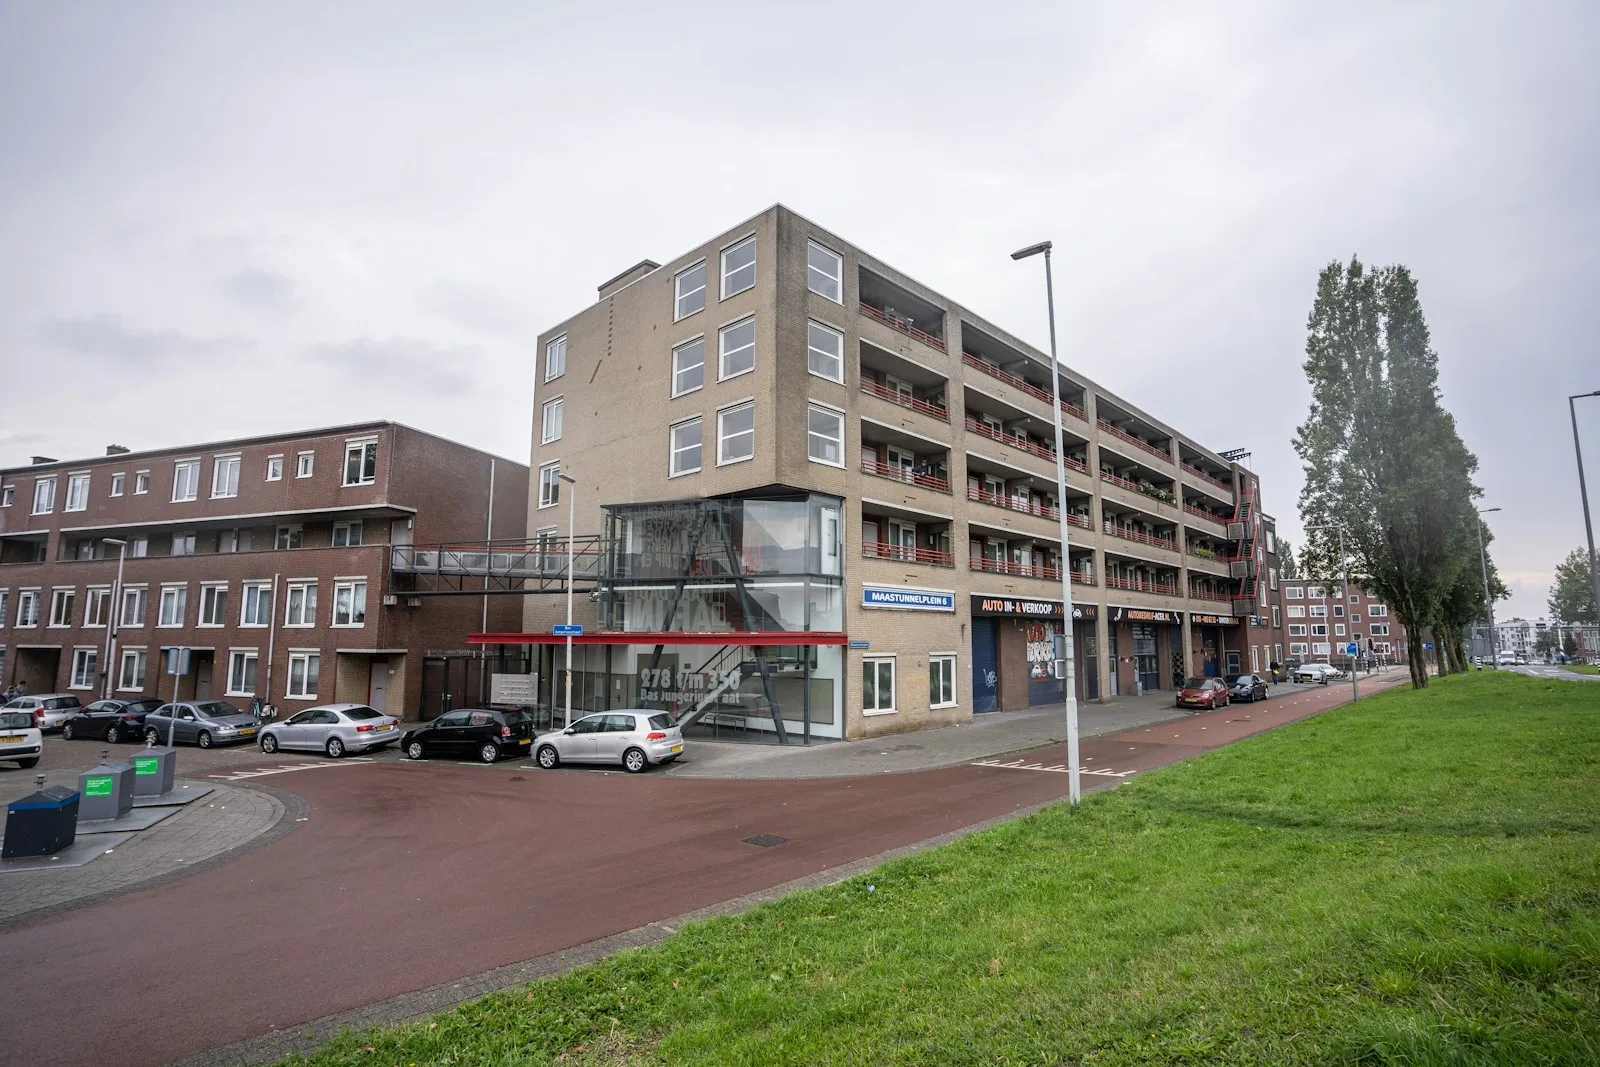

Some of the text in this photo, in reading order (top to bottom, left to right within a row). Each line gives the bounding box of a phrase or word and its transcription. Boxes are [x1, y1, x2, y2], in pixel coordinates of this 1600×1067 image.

[872, 592, 947, 605] MAASTUNNELPLEIN 6
[982, 599, 1052, 614] AUTO IN- & VERKOOP
[641, 668, 741, 690] 278 t/m 350
[640, 688, 659, 700] Bas
